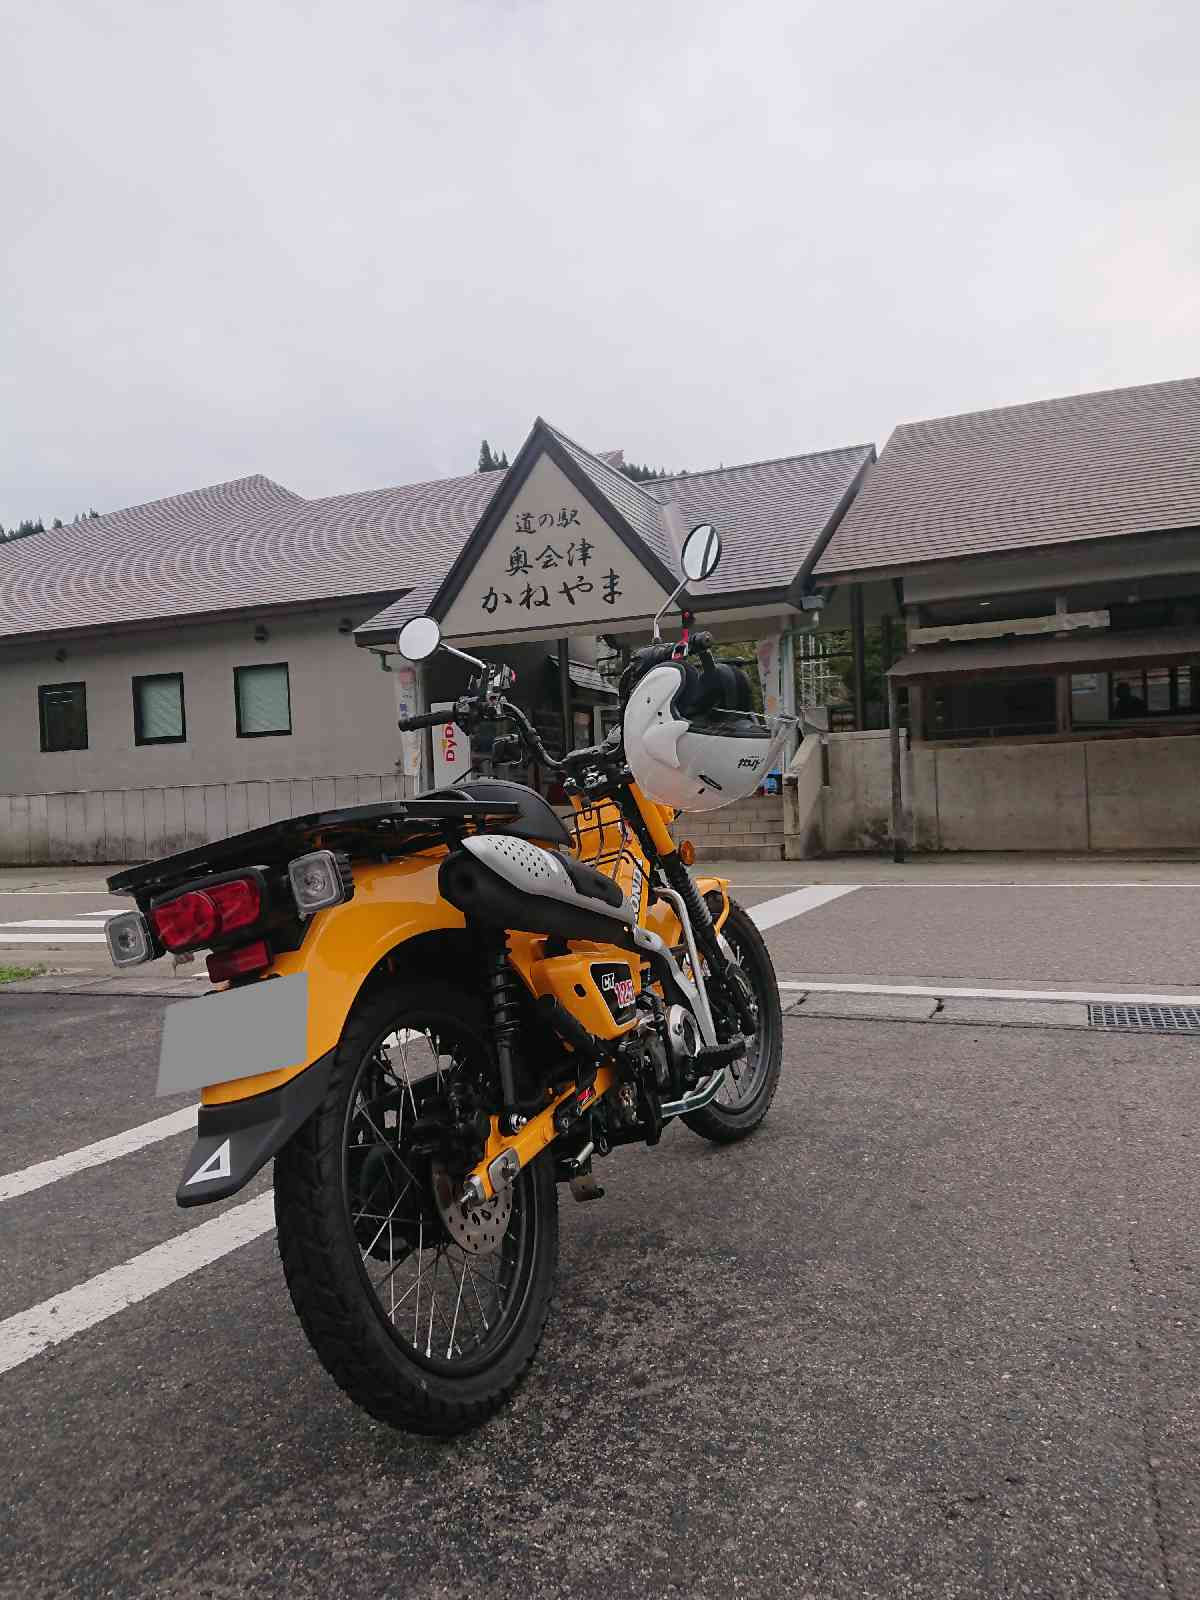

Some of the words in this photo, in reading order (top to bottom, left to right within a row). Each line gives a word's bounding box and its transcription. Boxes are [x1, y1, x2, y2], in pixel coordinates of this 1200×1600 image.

[515, 508, 581, 534] 道の駅
[505, 538, 595, 576] 奥会津
[481, 568, 622, 613] かねやま
[601, 972, 615, 991] CT
